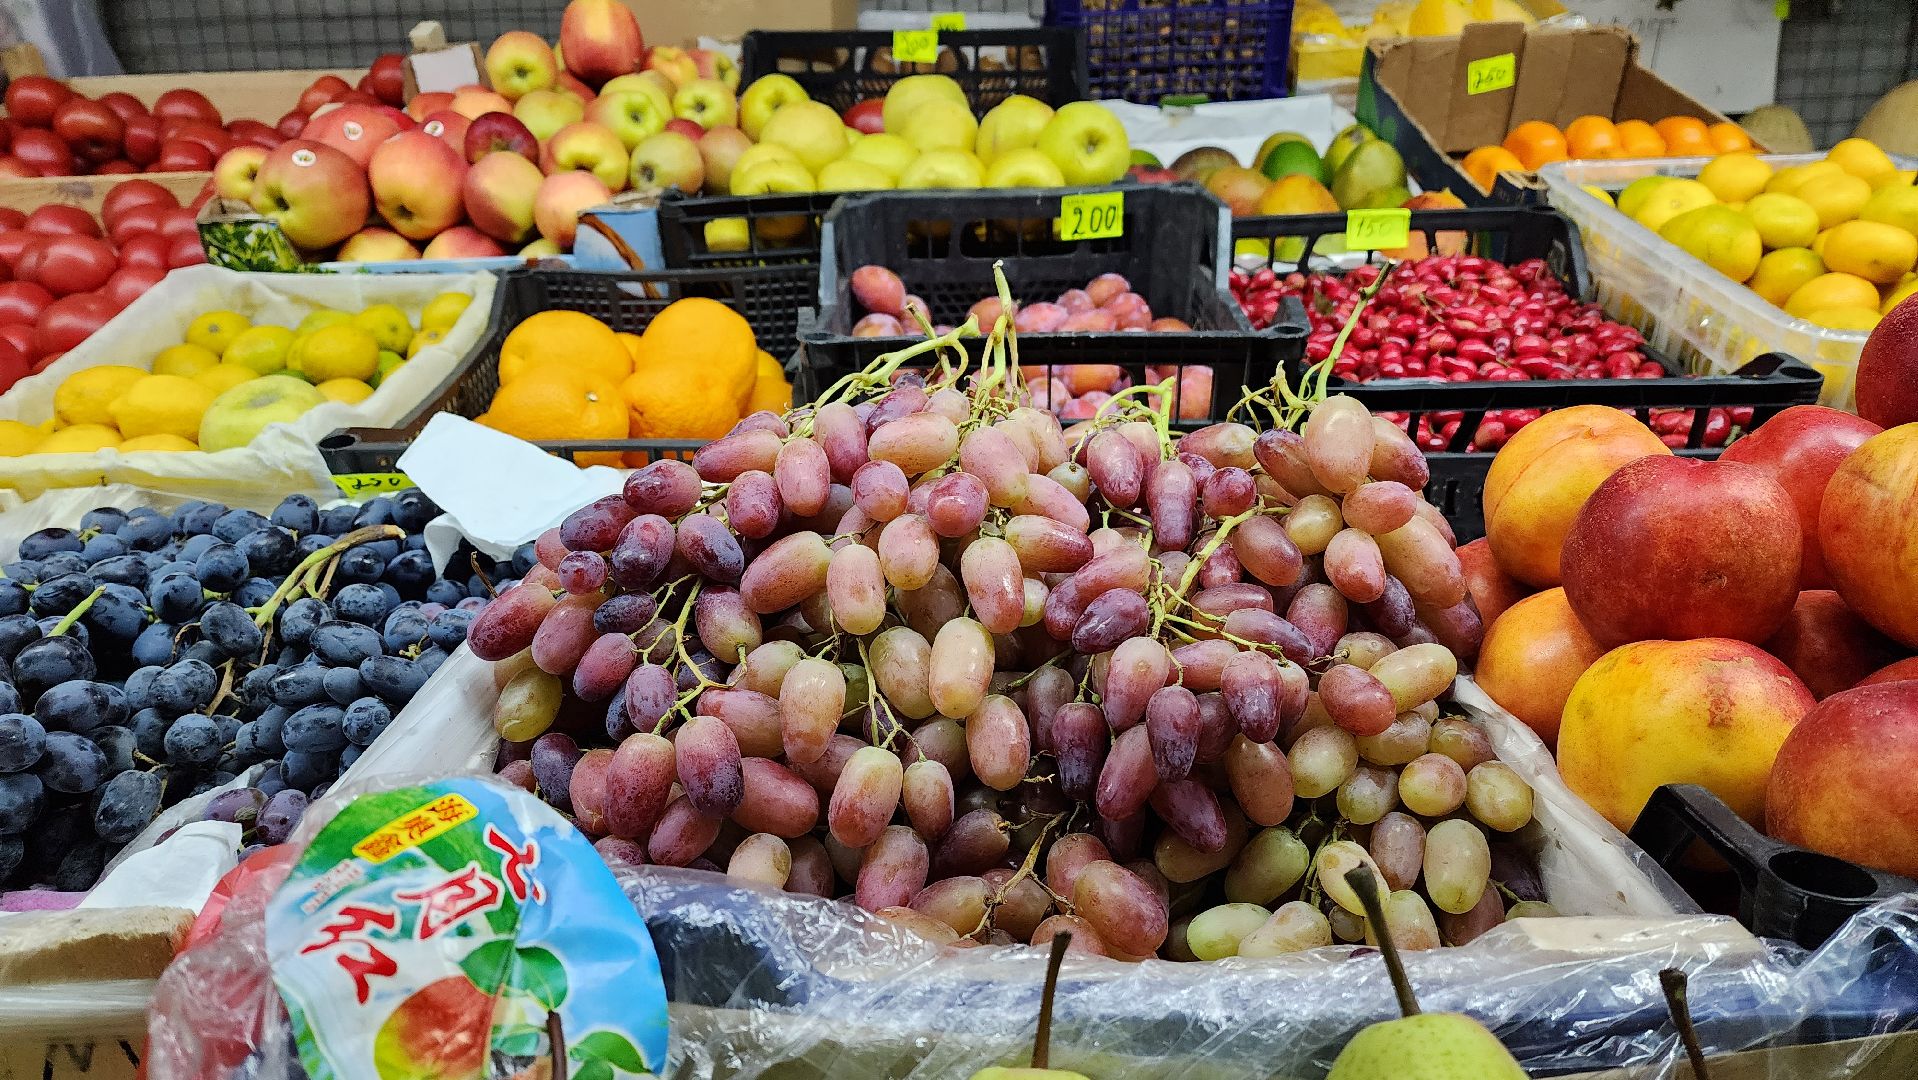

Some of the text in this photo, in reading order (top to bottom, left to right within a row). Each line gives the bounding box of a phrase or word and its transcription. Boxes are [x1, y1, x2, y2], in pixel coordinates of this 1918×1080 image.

[1072, 206, 1117, 236] 200
[1357, 216, 1392, 238] 150
[351, 477, 401, 490] 250
